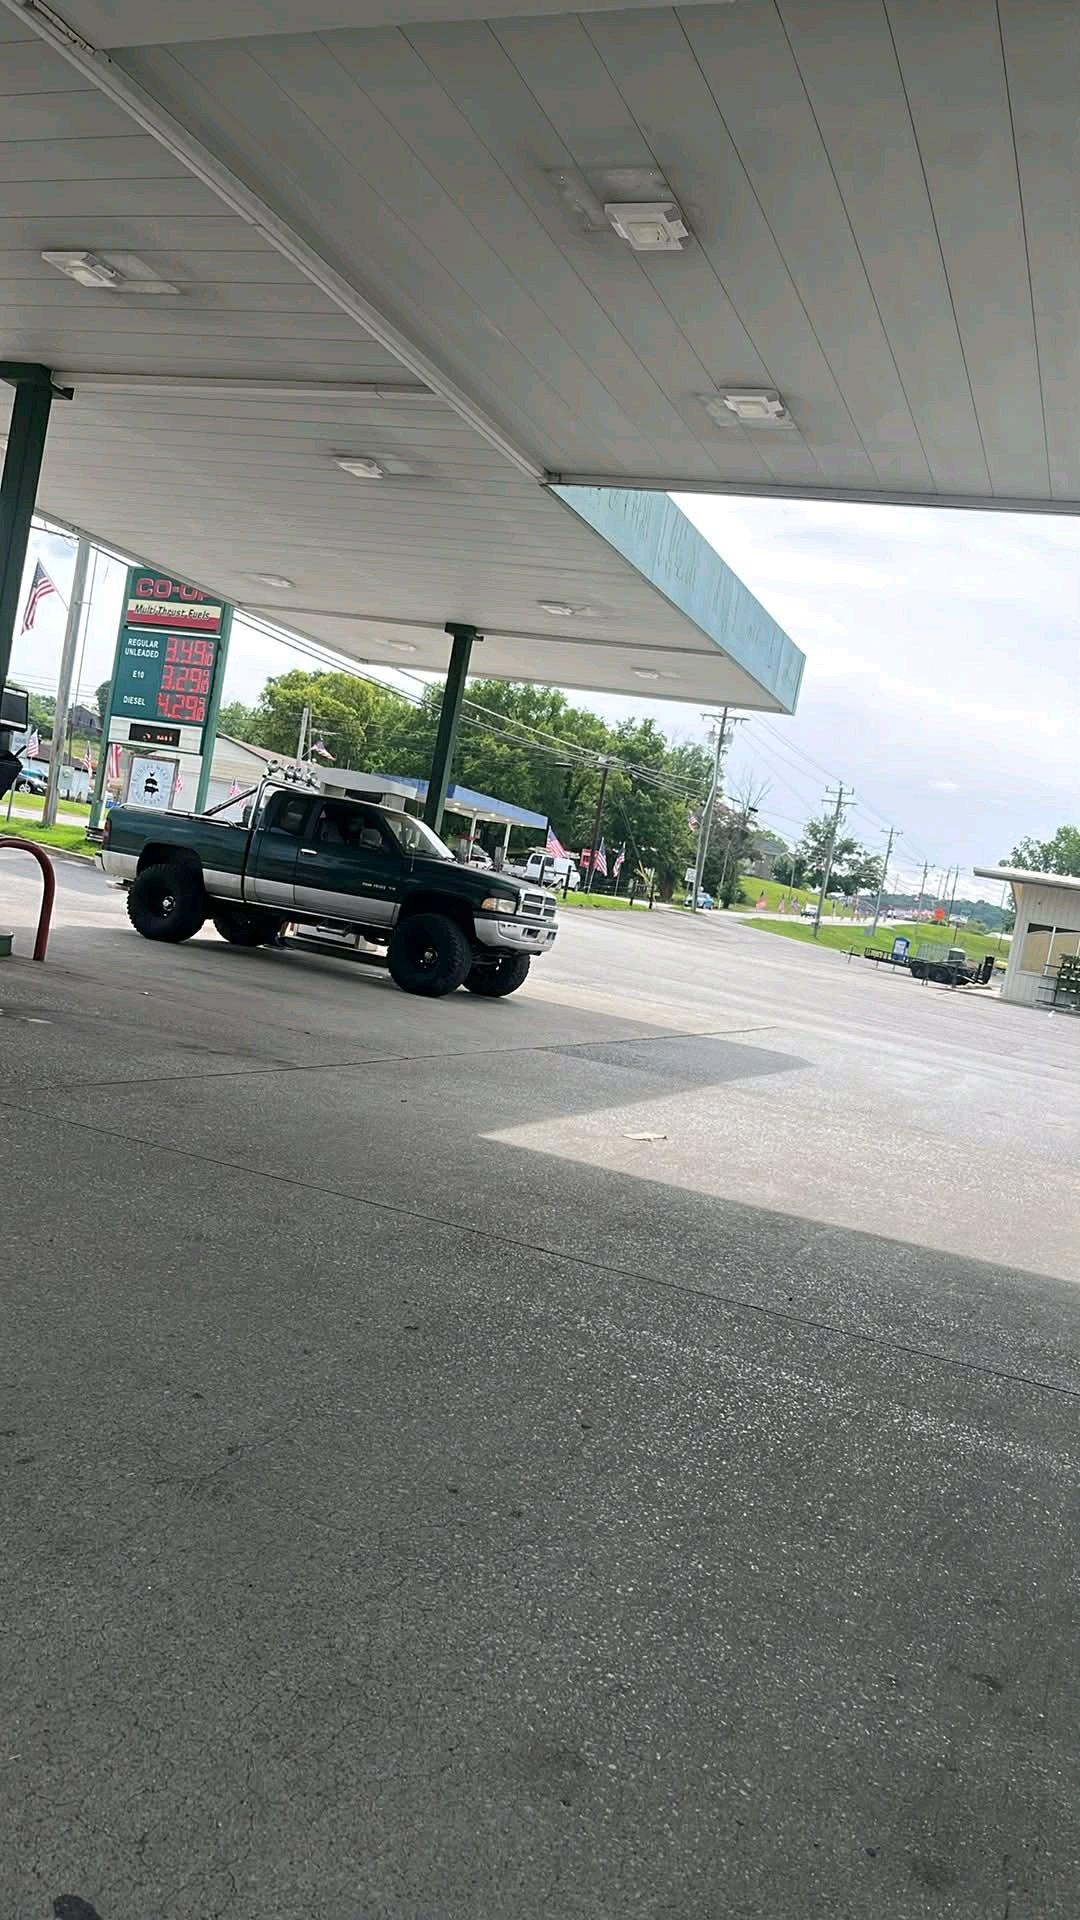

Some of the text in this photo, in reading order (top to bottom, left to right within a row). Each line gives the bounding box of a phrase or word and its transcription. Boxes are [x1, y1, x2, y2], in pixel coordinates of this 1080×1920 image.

[187, 608, 210, 620] Fuels
[128, 638, 159, 648] REGULAR
[125, 648, 159, 658] UNLEADED
[132, 670, 144, 679] E10
[123, 695, 146, 706] DIESEL
